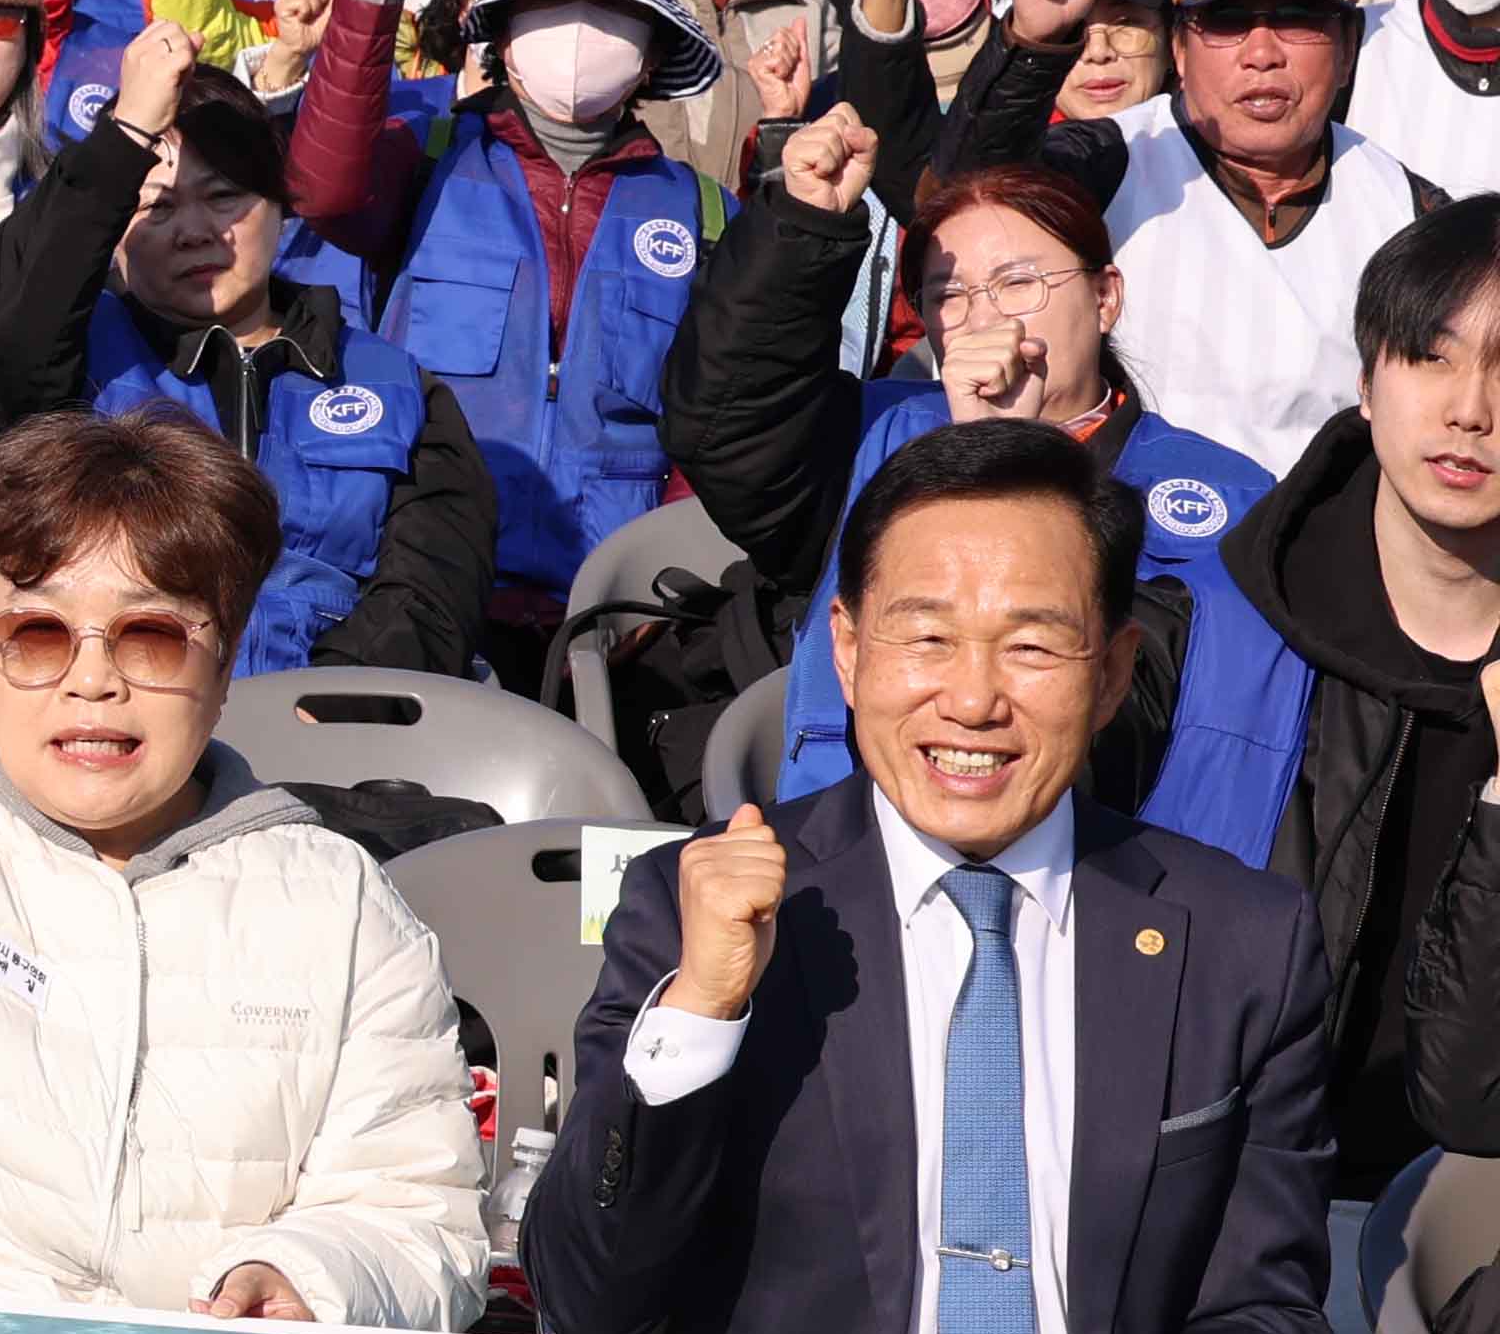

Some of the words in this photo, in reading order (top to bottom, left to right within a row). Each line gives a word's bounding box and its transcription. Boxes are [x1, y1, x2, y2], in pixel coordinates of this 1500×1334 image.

[648, 237, 685, 259] KFF
[327, 401, 367, 419] KFF
[1166, 498, 1211, 515] KFF
[230, 1000, 312, 1021] COVERNAT
